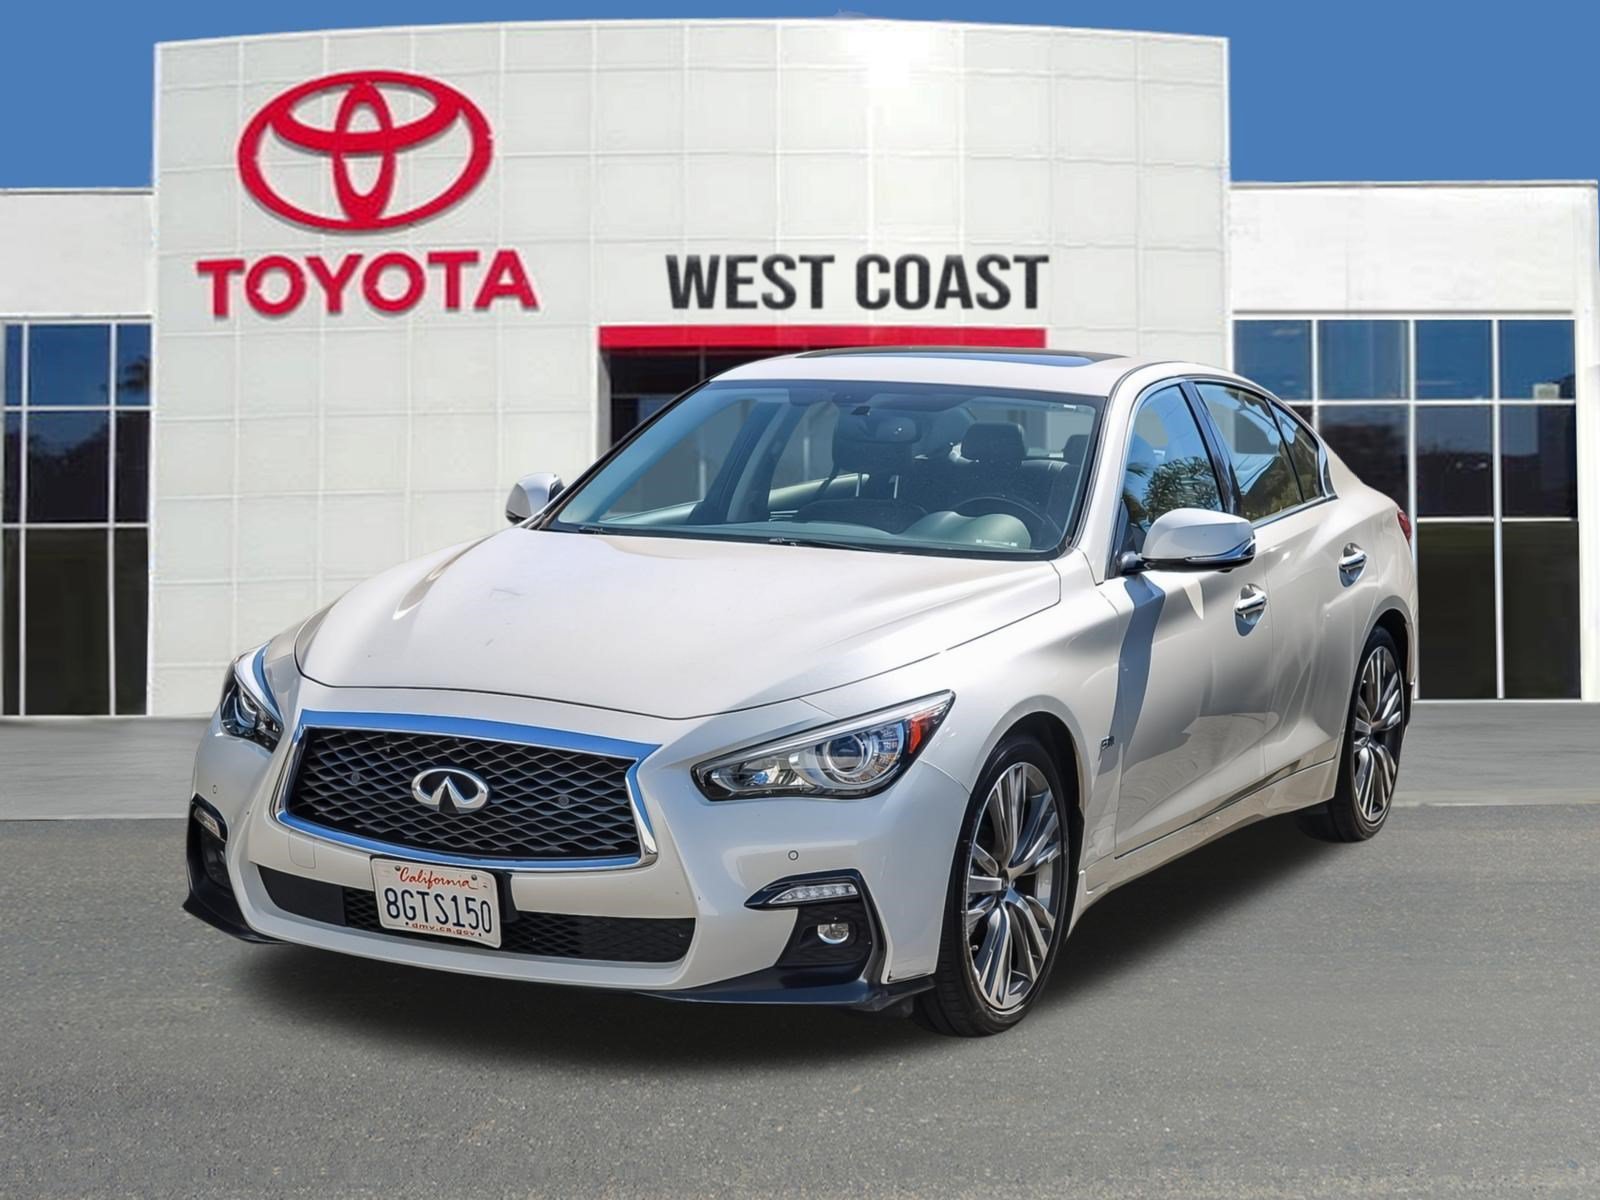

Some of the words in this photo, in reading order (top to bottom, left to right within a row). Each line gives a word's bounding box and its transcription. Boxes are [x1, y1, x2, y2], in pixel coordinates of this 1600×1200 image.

[196, 249, 539, 318] TOYOTA
[665, 254, 835, 310] WEST
[855, 253, 1050, 310] COAST
[400, 866, 478, 890] California
[384, 887, 492, 934] 8GTS150
